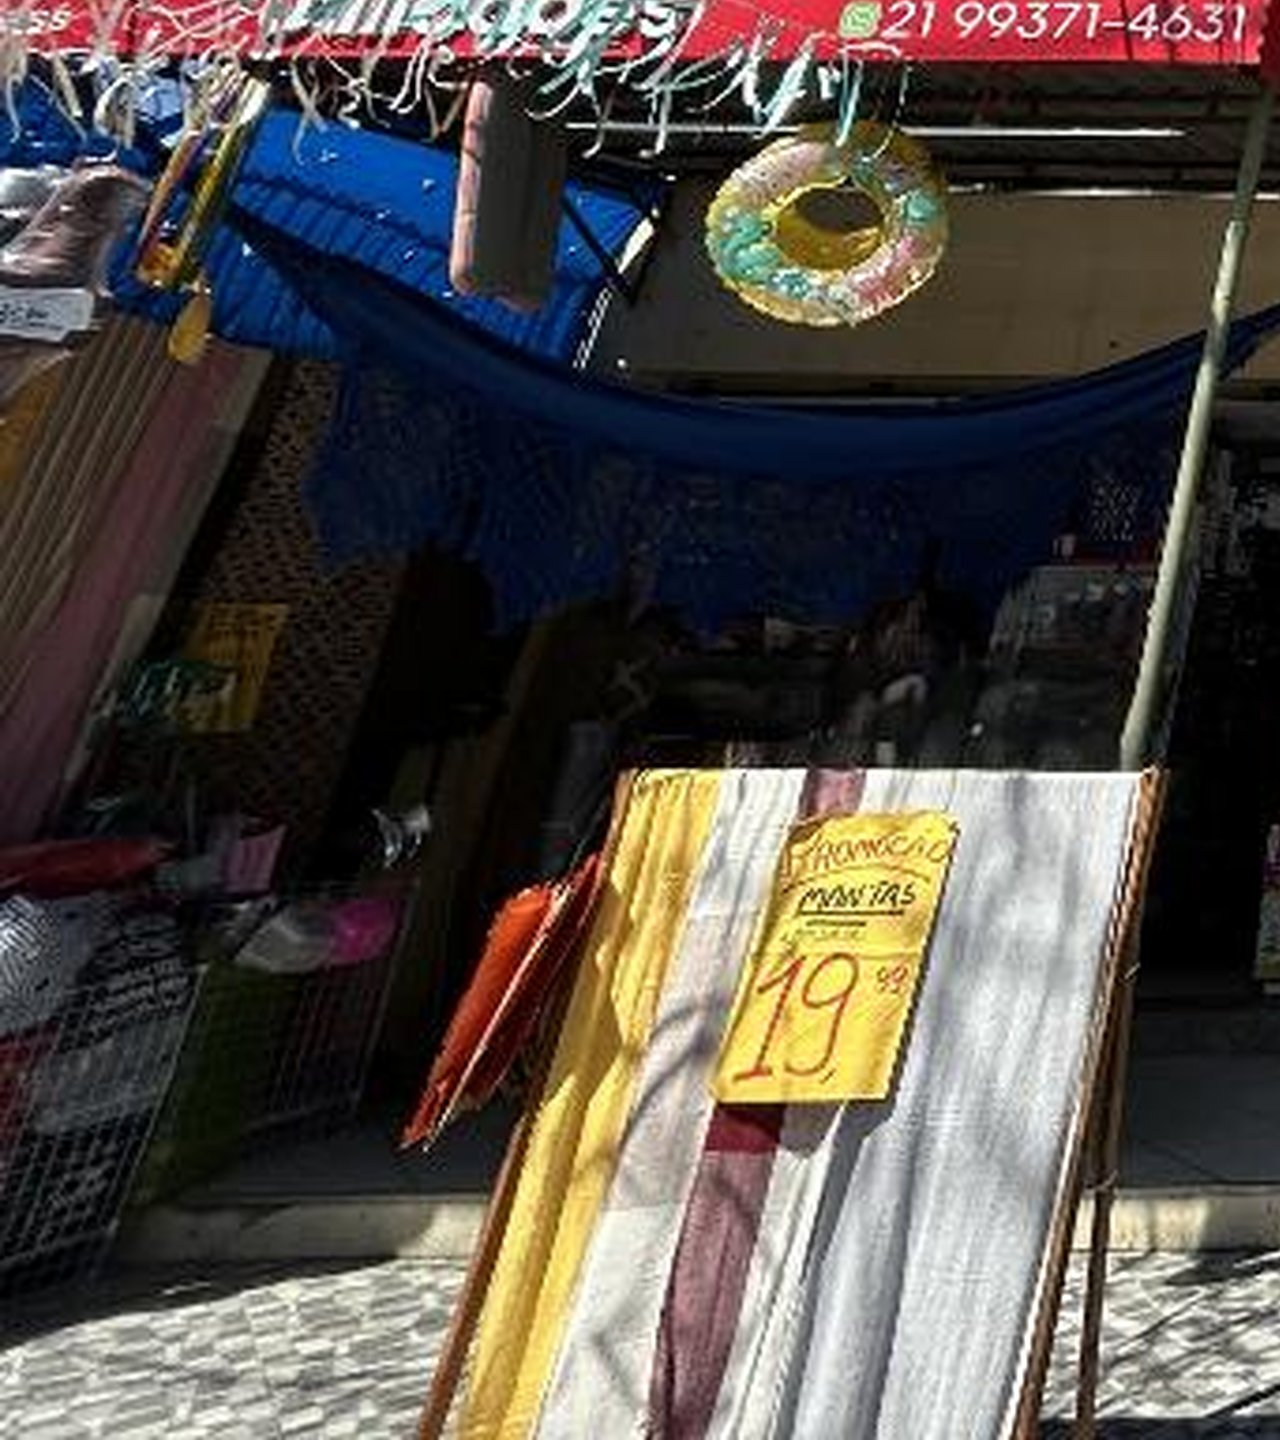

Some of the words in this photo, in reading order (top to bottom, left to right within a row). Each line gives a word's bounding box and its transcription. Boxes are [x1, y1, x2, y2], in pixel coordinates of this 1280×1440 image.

[880, 0, 936, 40] 21
[953, 0, 1246, 44] 99371-4631
[798, 880, 917, 912] MANTAS
[732, 951, 860, 1083] 19
[875, 965, 909, 995] 99
